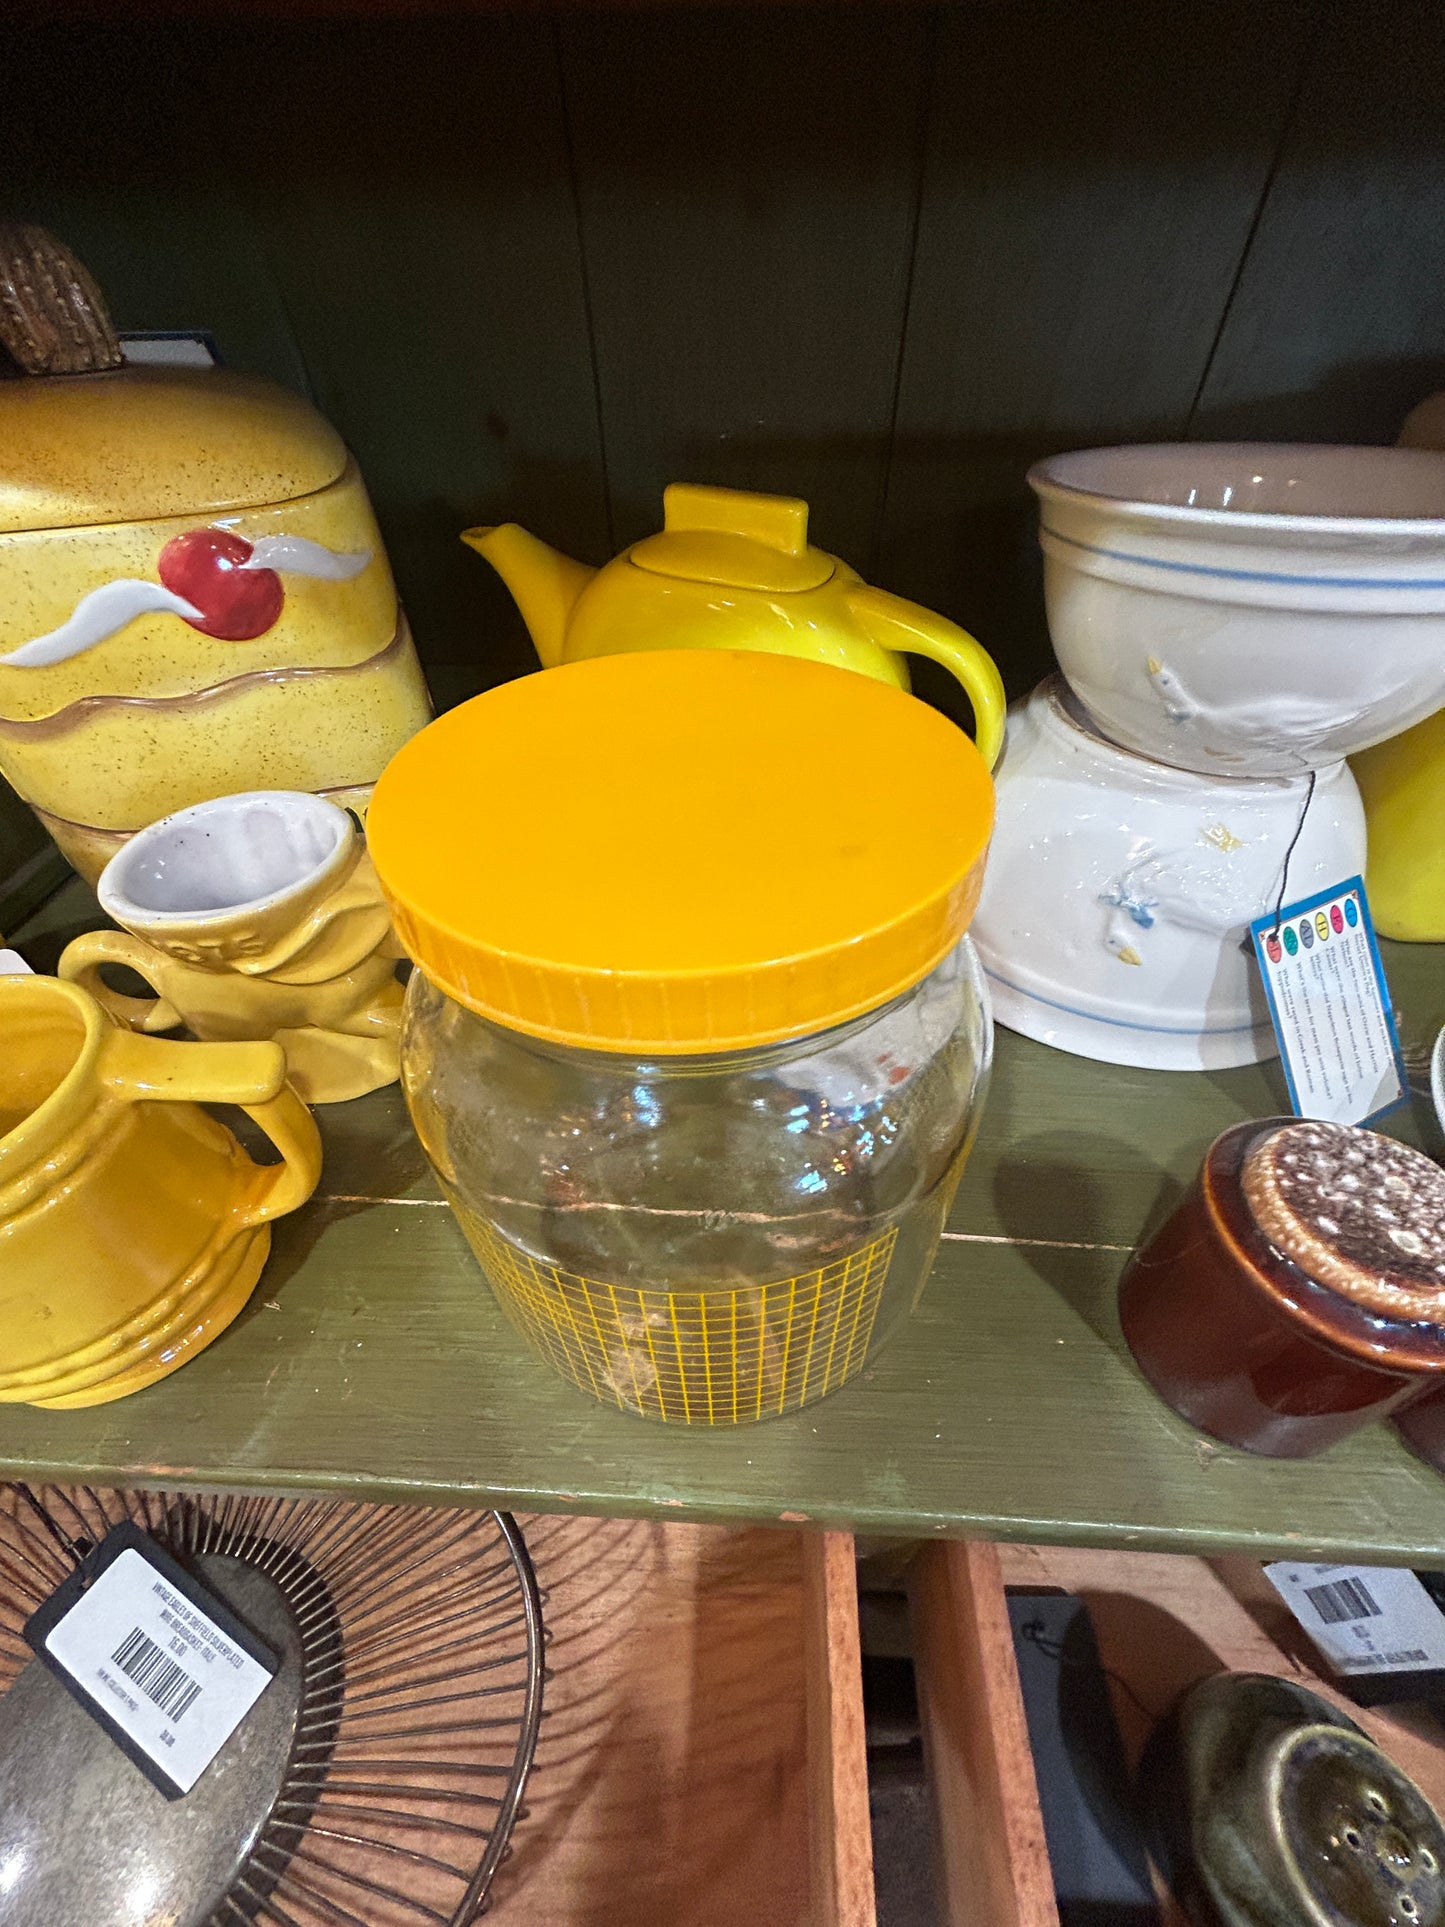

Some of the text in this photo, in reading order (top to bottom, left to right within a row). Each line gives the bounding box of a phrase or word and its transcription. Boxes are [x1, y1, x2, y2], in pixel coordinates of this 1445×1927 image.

[1281, 968, 1291, 987] What
[1296, 1033, 1306, 1053] Greek
[1301, 1054, 1310, 1068] and
[1313, 1044, 1321, 1056] per
